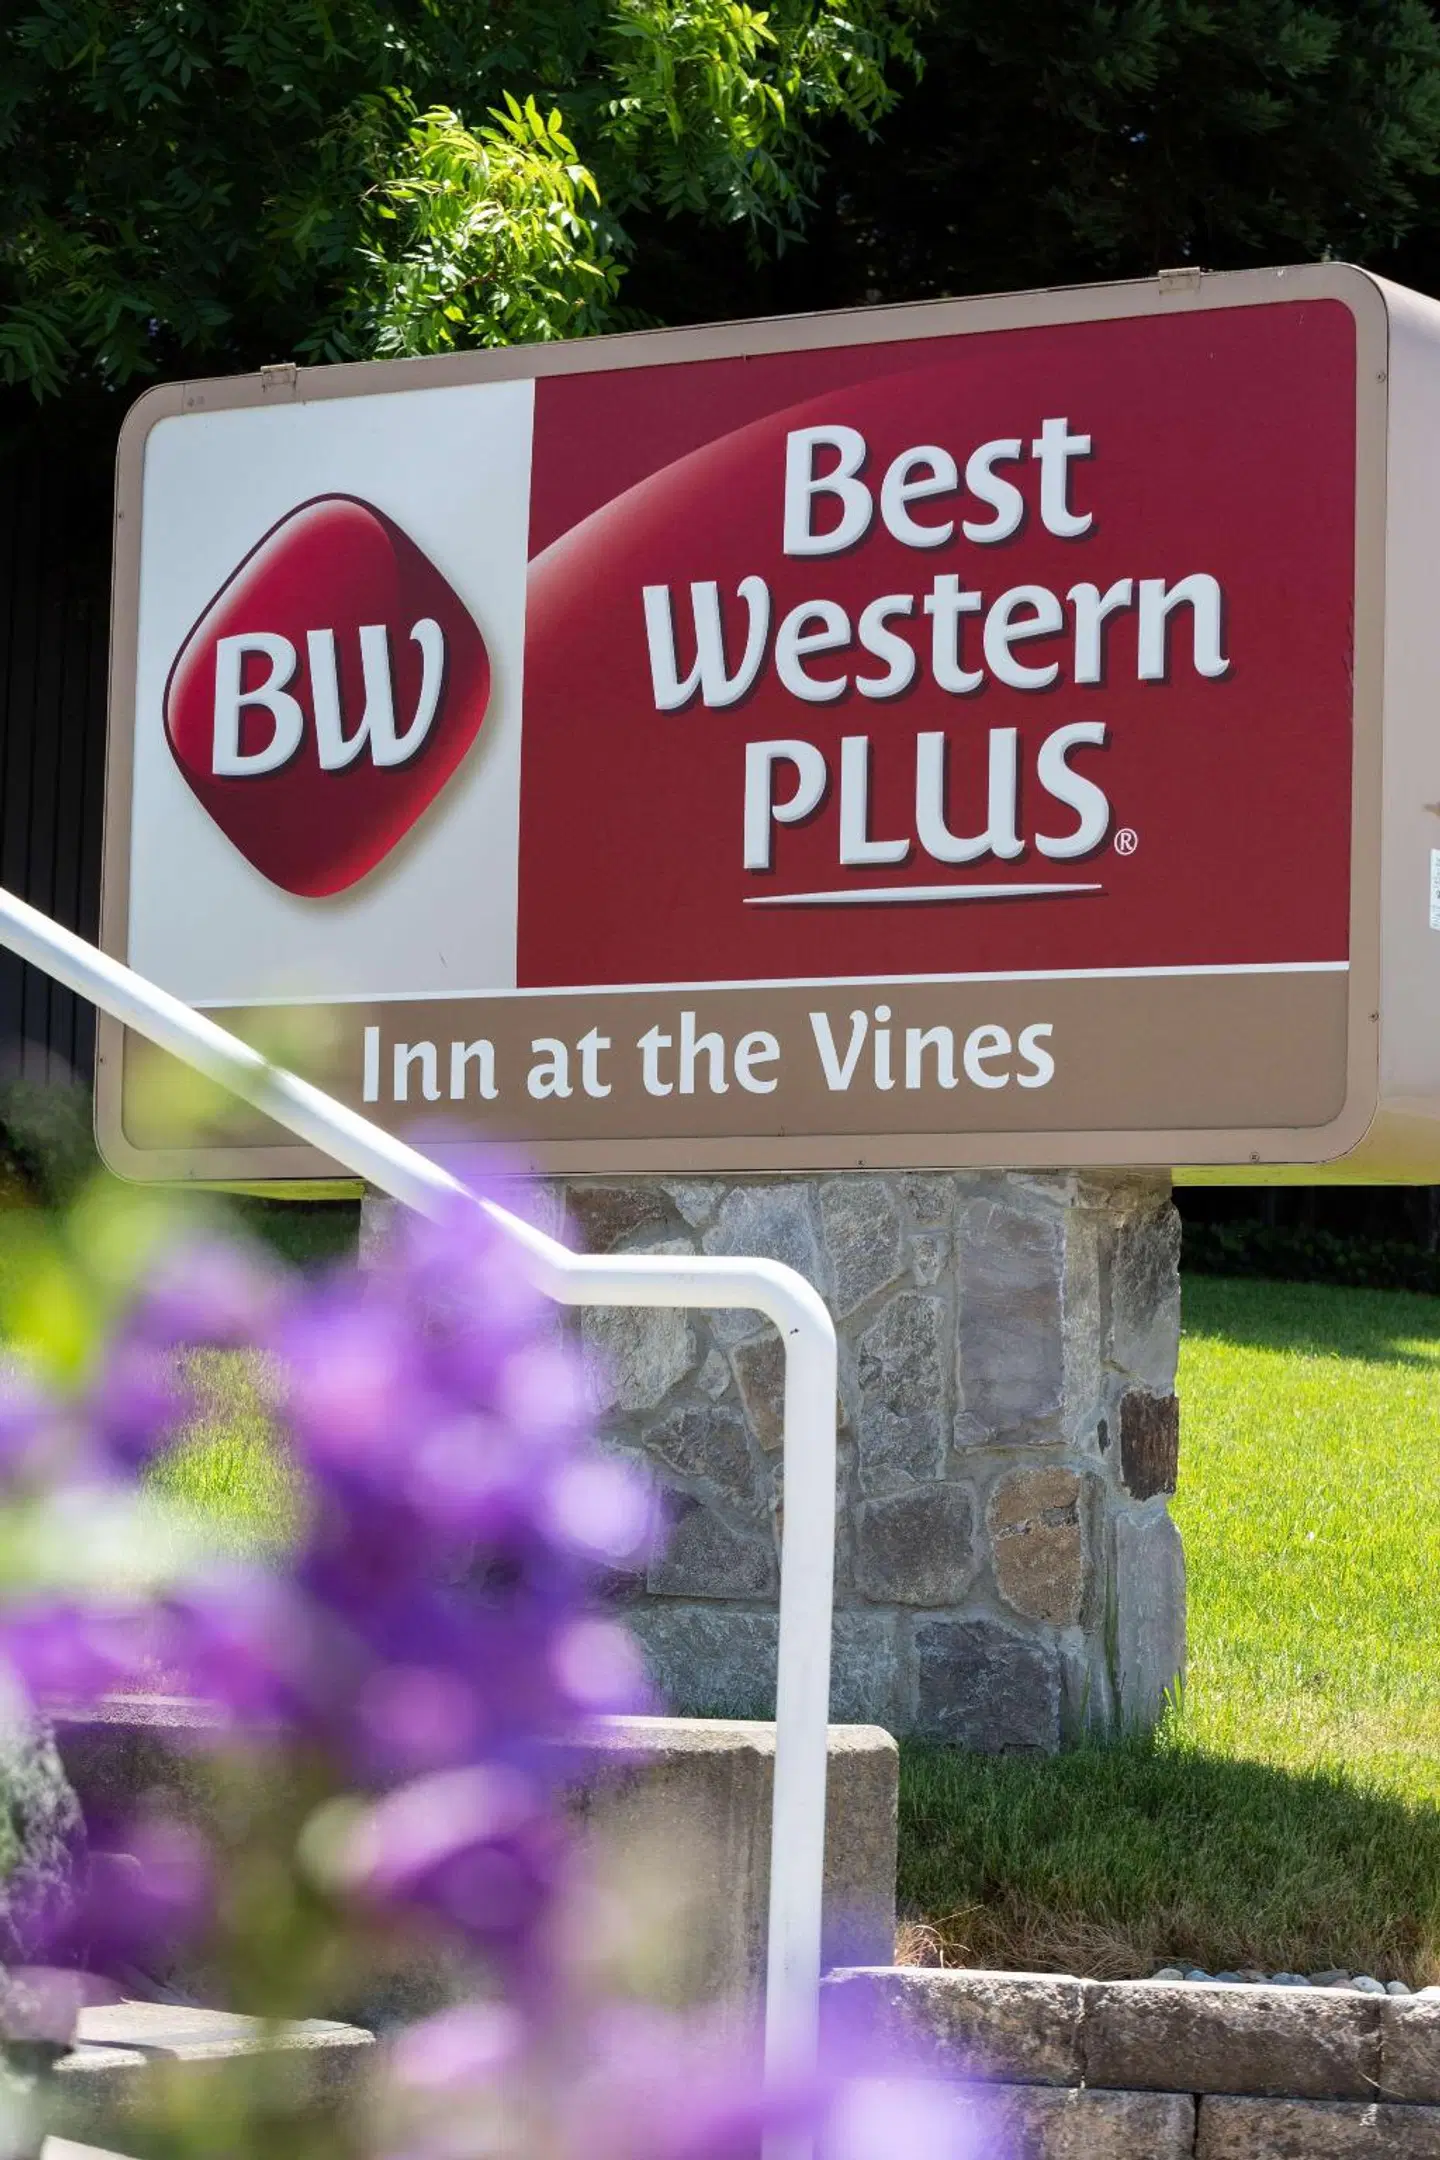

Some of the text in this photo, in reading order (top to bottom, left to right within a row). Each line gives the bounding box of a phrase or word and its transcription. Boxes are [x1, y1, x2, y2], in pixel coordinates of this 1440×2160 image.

[783, 417, 1093, 555] Best
[212, 618, 445, 776] BW
[642, 573, 1230, 710] Western
[362, 1005, 1055, 1102] Inn at the Vines
